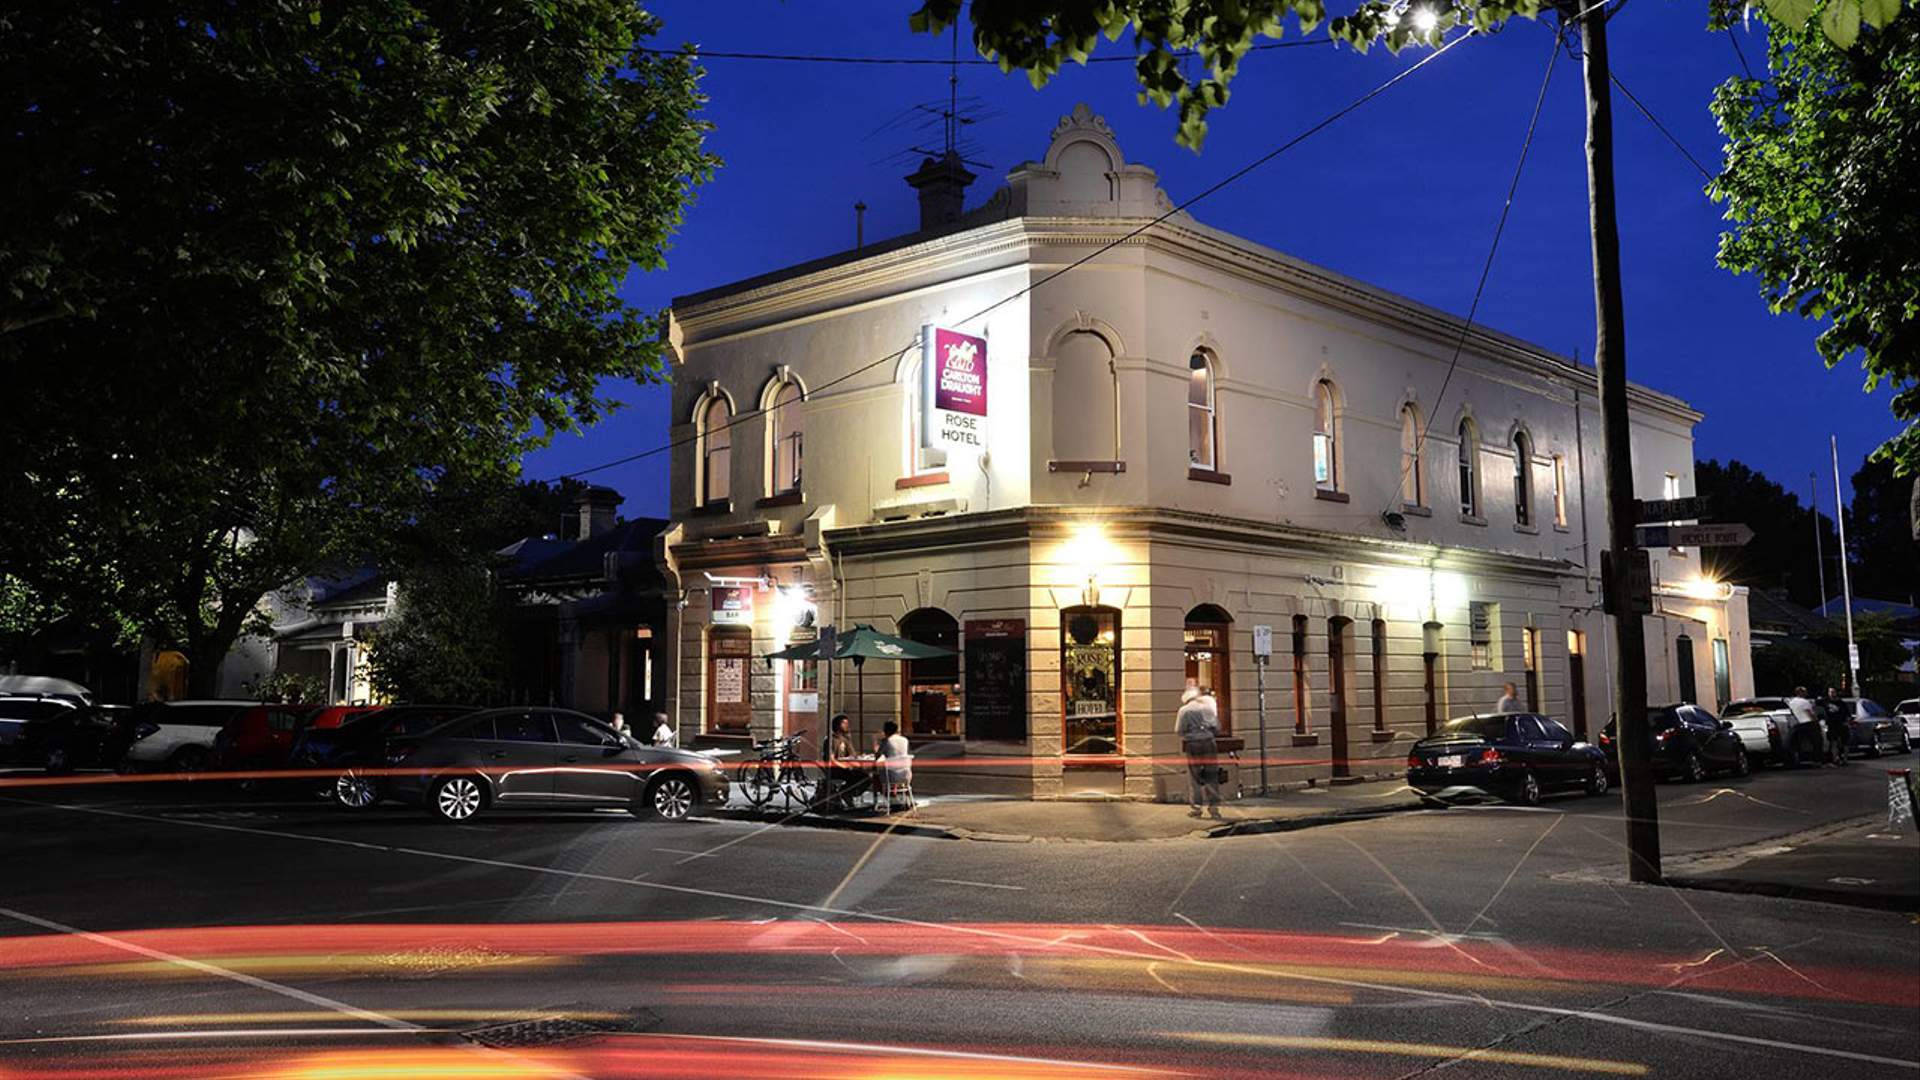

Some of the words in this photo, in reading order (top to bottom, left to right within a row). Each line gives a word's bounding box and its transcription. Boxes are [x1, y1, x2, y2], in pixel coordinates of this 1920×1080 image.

[946, 413, 977, 430] ROSE
[942, 429, 981, 446] HOTEL
[1643, 500, 1687, 515] NAPIER
[1077, 652, 1104, 666] ROSE
[1078, 703, 1103, 714] HOTEL
